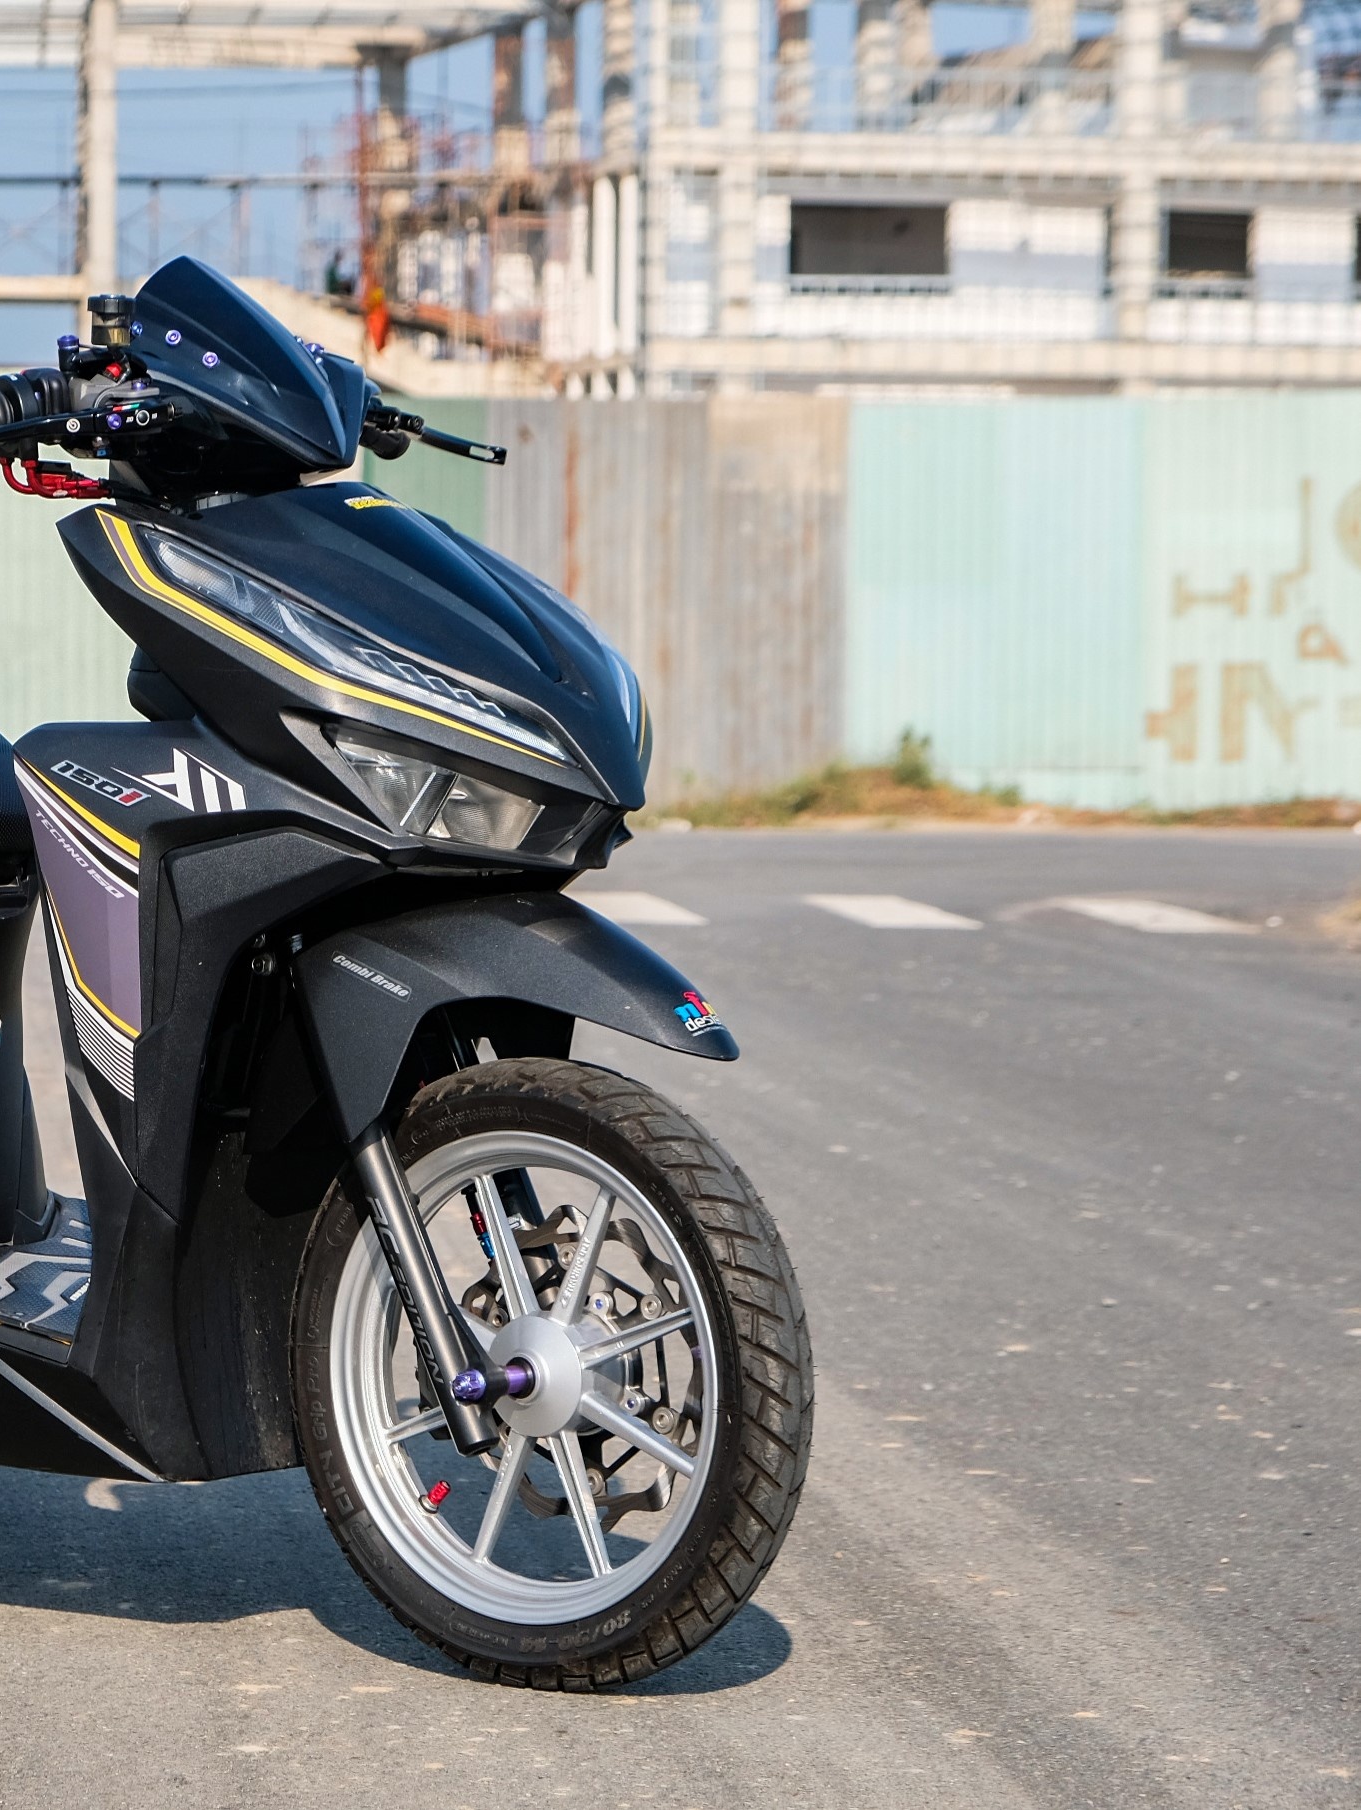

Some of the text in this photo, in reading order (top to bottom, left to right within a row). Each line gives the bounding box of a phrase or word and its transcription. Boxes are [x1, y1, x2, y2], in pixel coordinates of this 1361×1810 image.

[54, 760, 145, 806] 150i
[35, 809, 126, 899] TECHNO 150
[332, 955, 410, 997] Combi Brake
